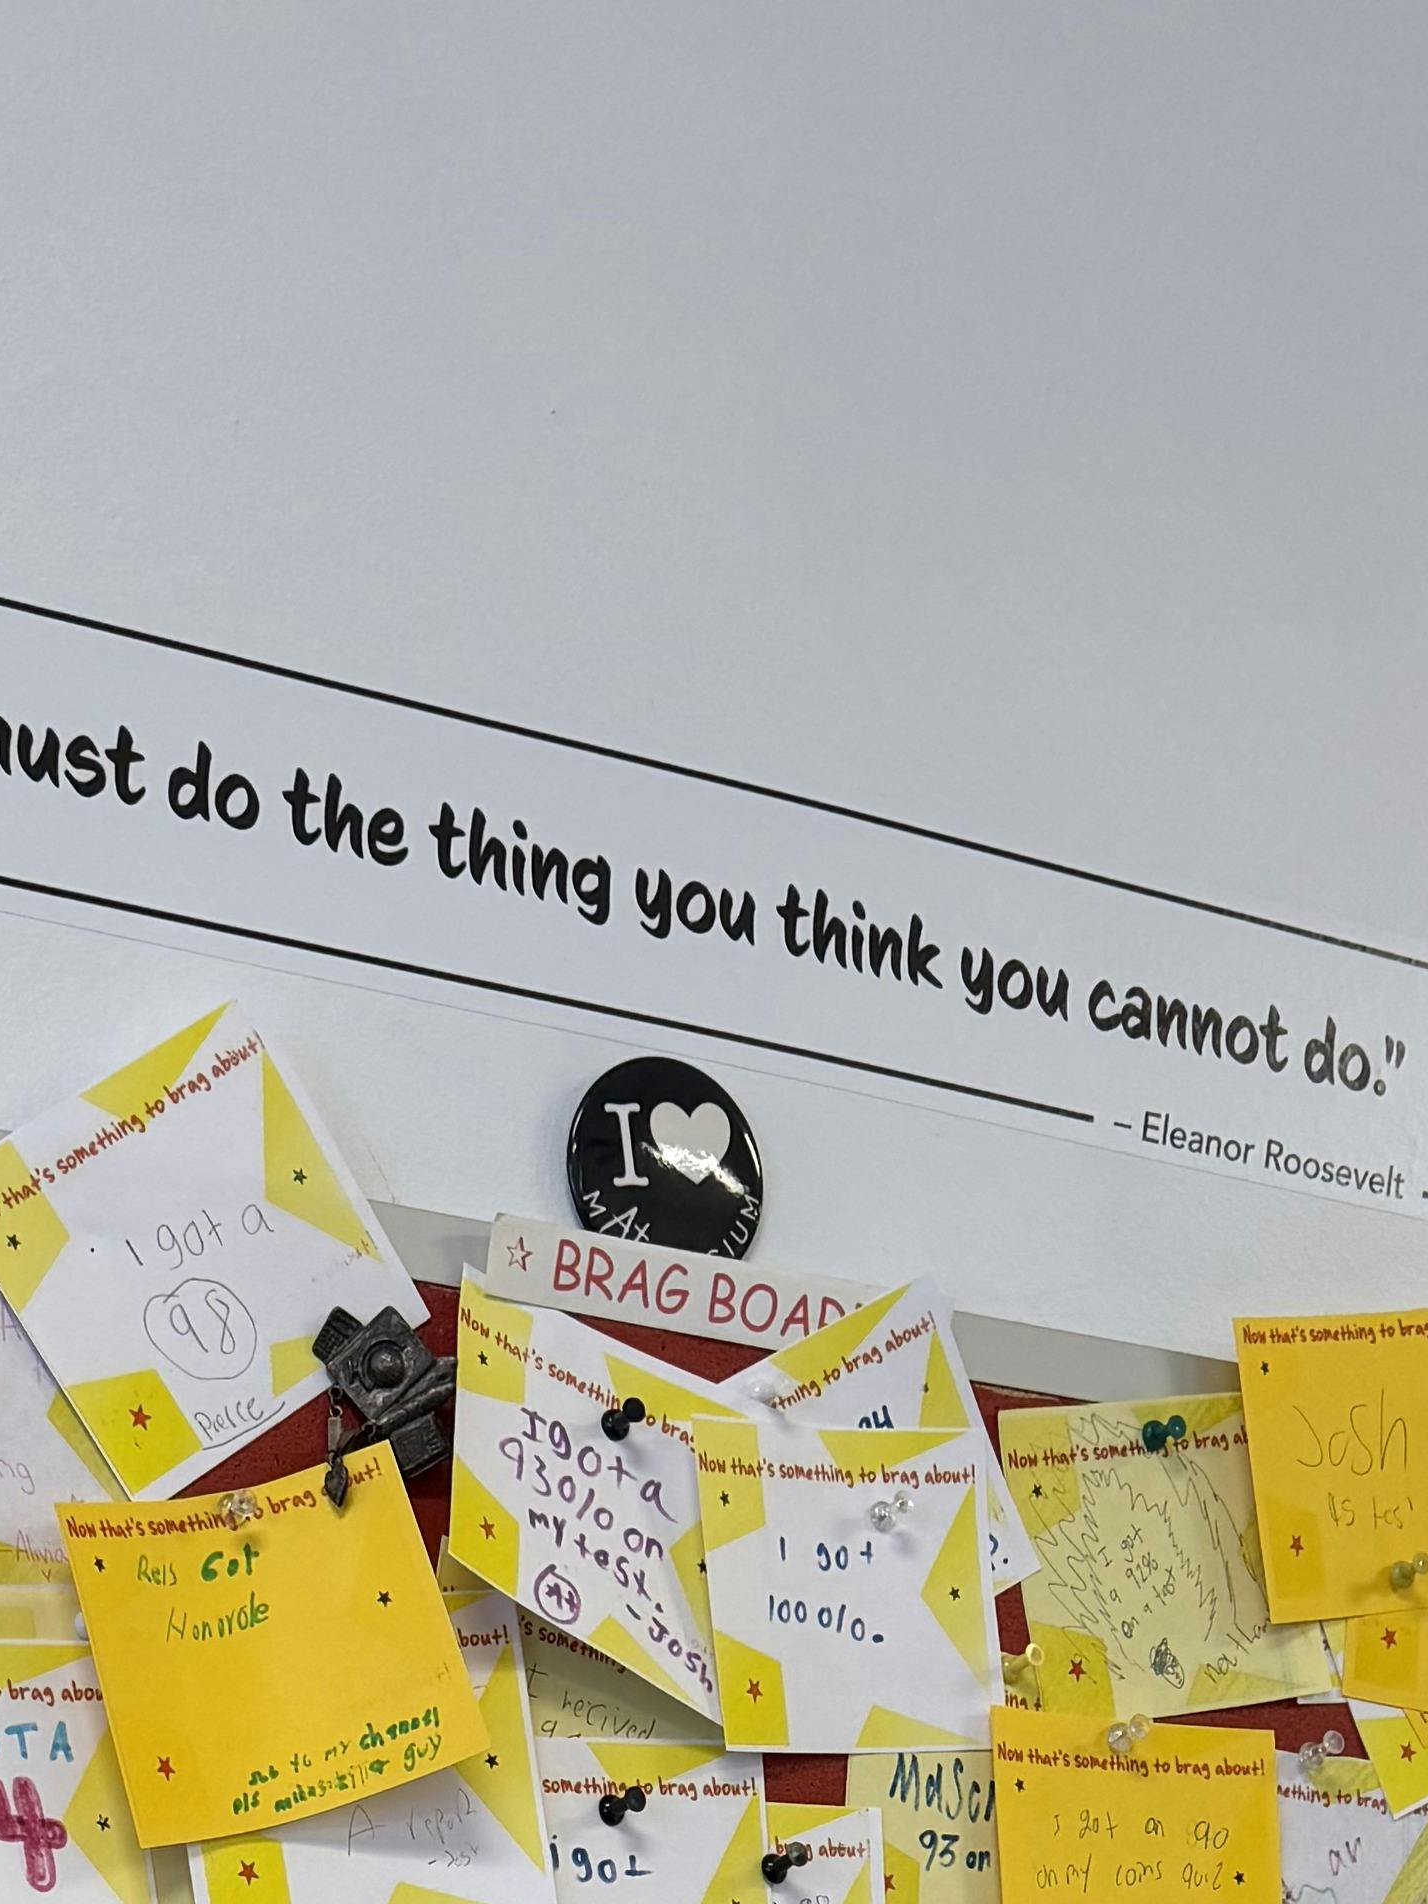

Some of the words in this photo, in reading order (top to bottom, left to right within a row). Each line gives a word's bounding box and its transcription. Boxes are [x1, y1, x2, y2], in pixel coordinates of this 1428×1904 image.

[169, 742, 260, 829] do
[284, 768, 408, 866] the
[429, 801, 612, 925] thing
[637, 868, 756, 939] you
[779, 883, 945, 990] think
[962, 946, 1070, 1015] you
[1089, 979, 1287, 1072] cannot
[3, 1168, 57, 1211] that's
[57, 1114, 146, 1176] something
[146, 1098, 165, 1118] to
[165, 1071, 210, 1104] brag
[211, 1031, 266, 1079] about!
[602, 1101, 650, 1188] I
[1142, 1112, 1255, 1167] Eleanor
[1264, 1139, 1404, 1201] Roosevelt
[155, 1209, 222, 1271] got
[242, 1203, 274, 1237] a
[552, 1239, 690, 1315] BRAG
[168, 1289, 236, 1355] 98
[699, 1453, 727, 1476] Now
[730, 1457, 775, 1479] that's
[780, 1460, 853, 1487] something
[859, 1464, 877, 1484] to
[881, 1465, 920, 1488] brag
[925, 1465, 976, 1486] about!
